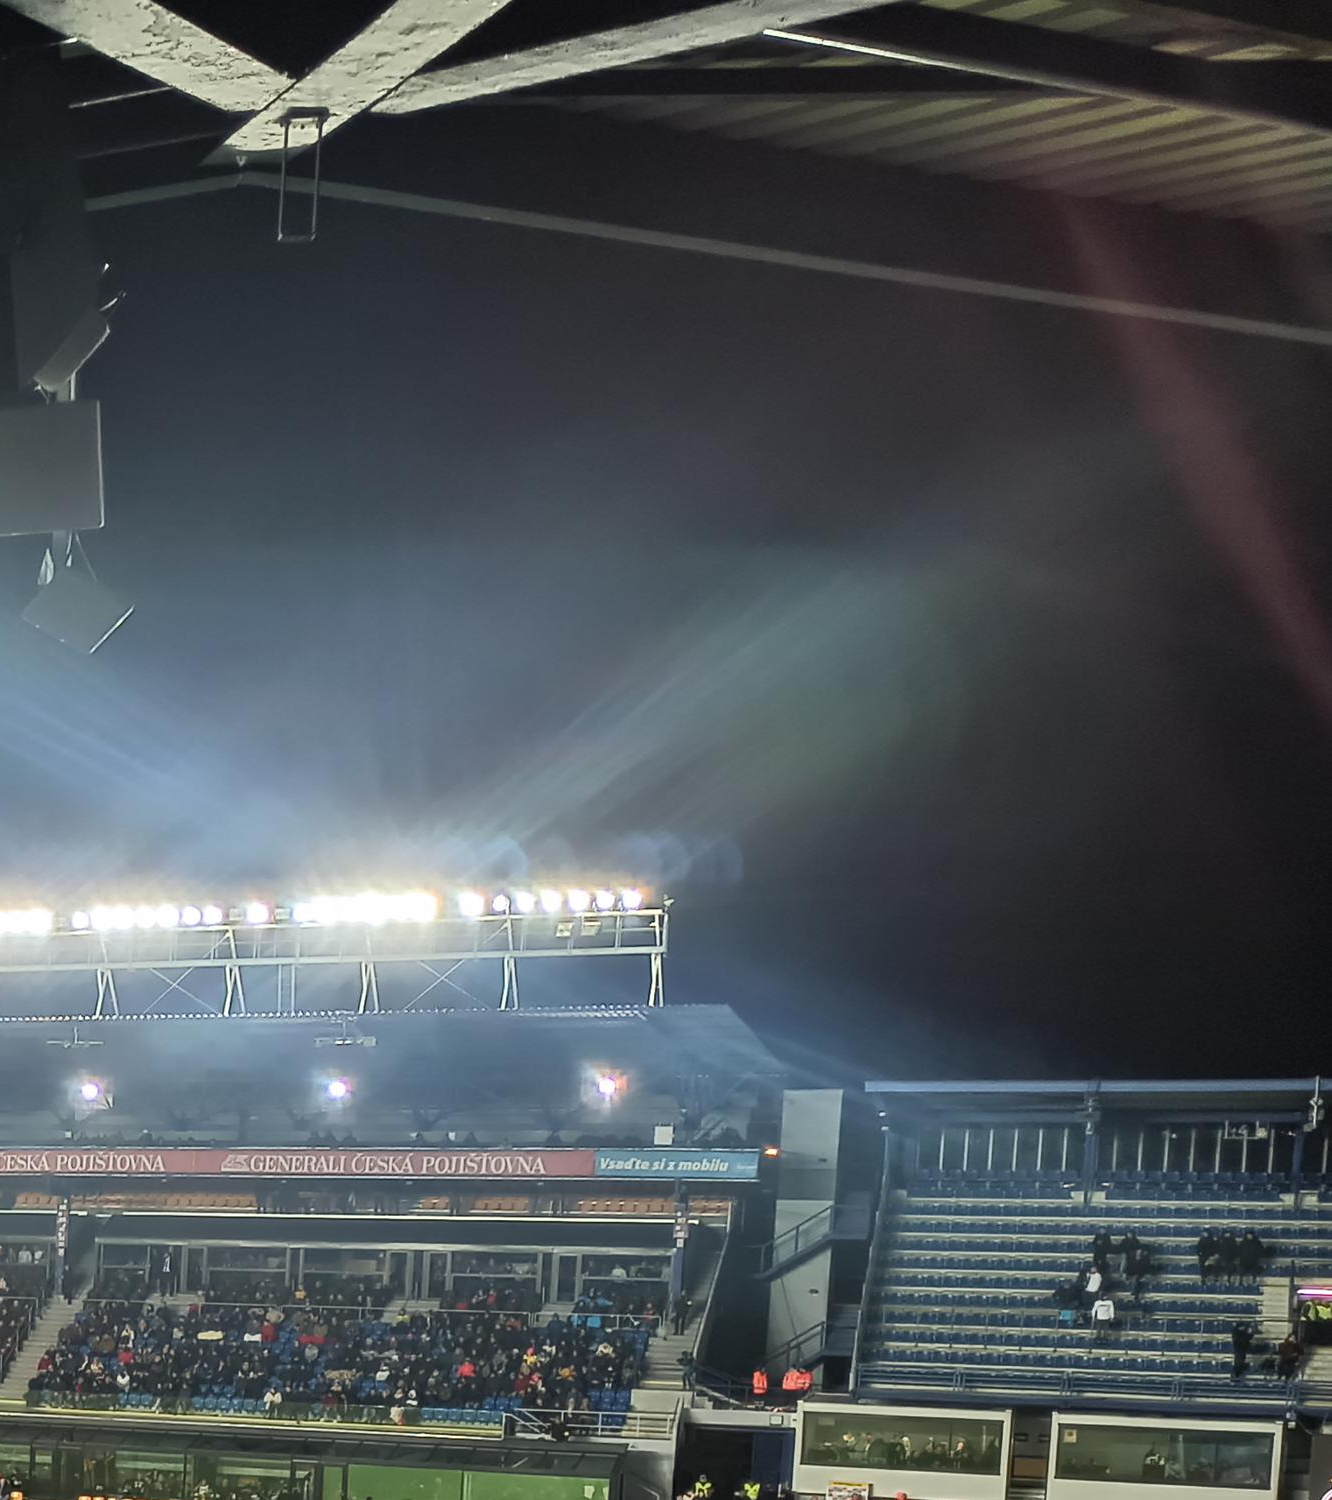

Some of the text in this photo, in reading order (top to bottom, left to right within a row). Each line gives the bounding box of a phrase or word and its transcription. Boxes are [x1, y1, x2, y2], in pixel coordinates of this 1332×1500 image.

[56, 1151, 165, 1172] POJIŠŤOVNA
[249, 1153, 546, 1174] GENERALI ČESKÁ POJIŠŤOVNA
[599, 1158, 649, 1170] Vsaďte
[652, 1158, 664, 1170] si
[668, 1161, 675, 1170] z
[678, 1159, 729, 1172] mobilu
